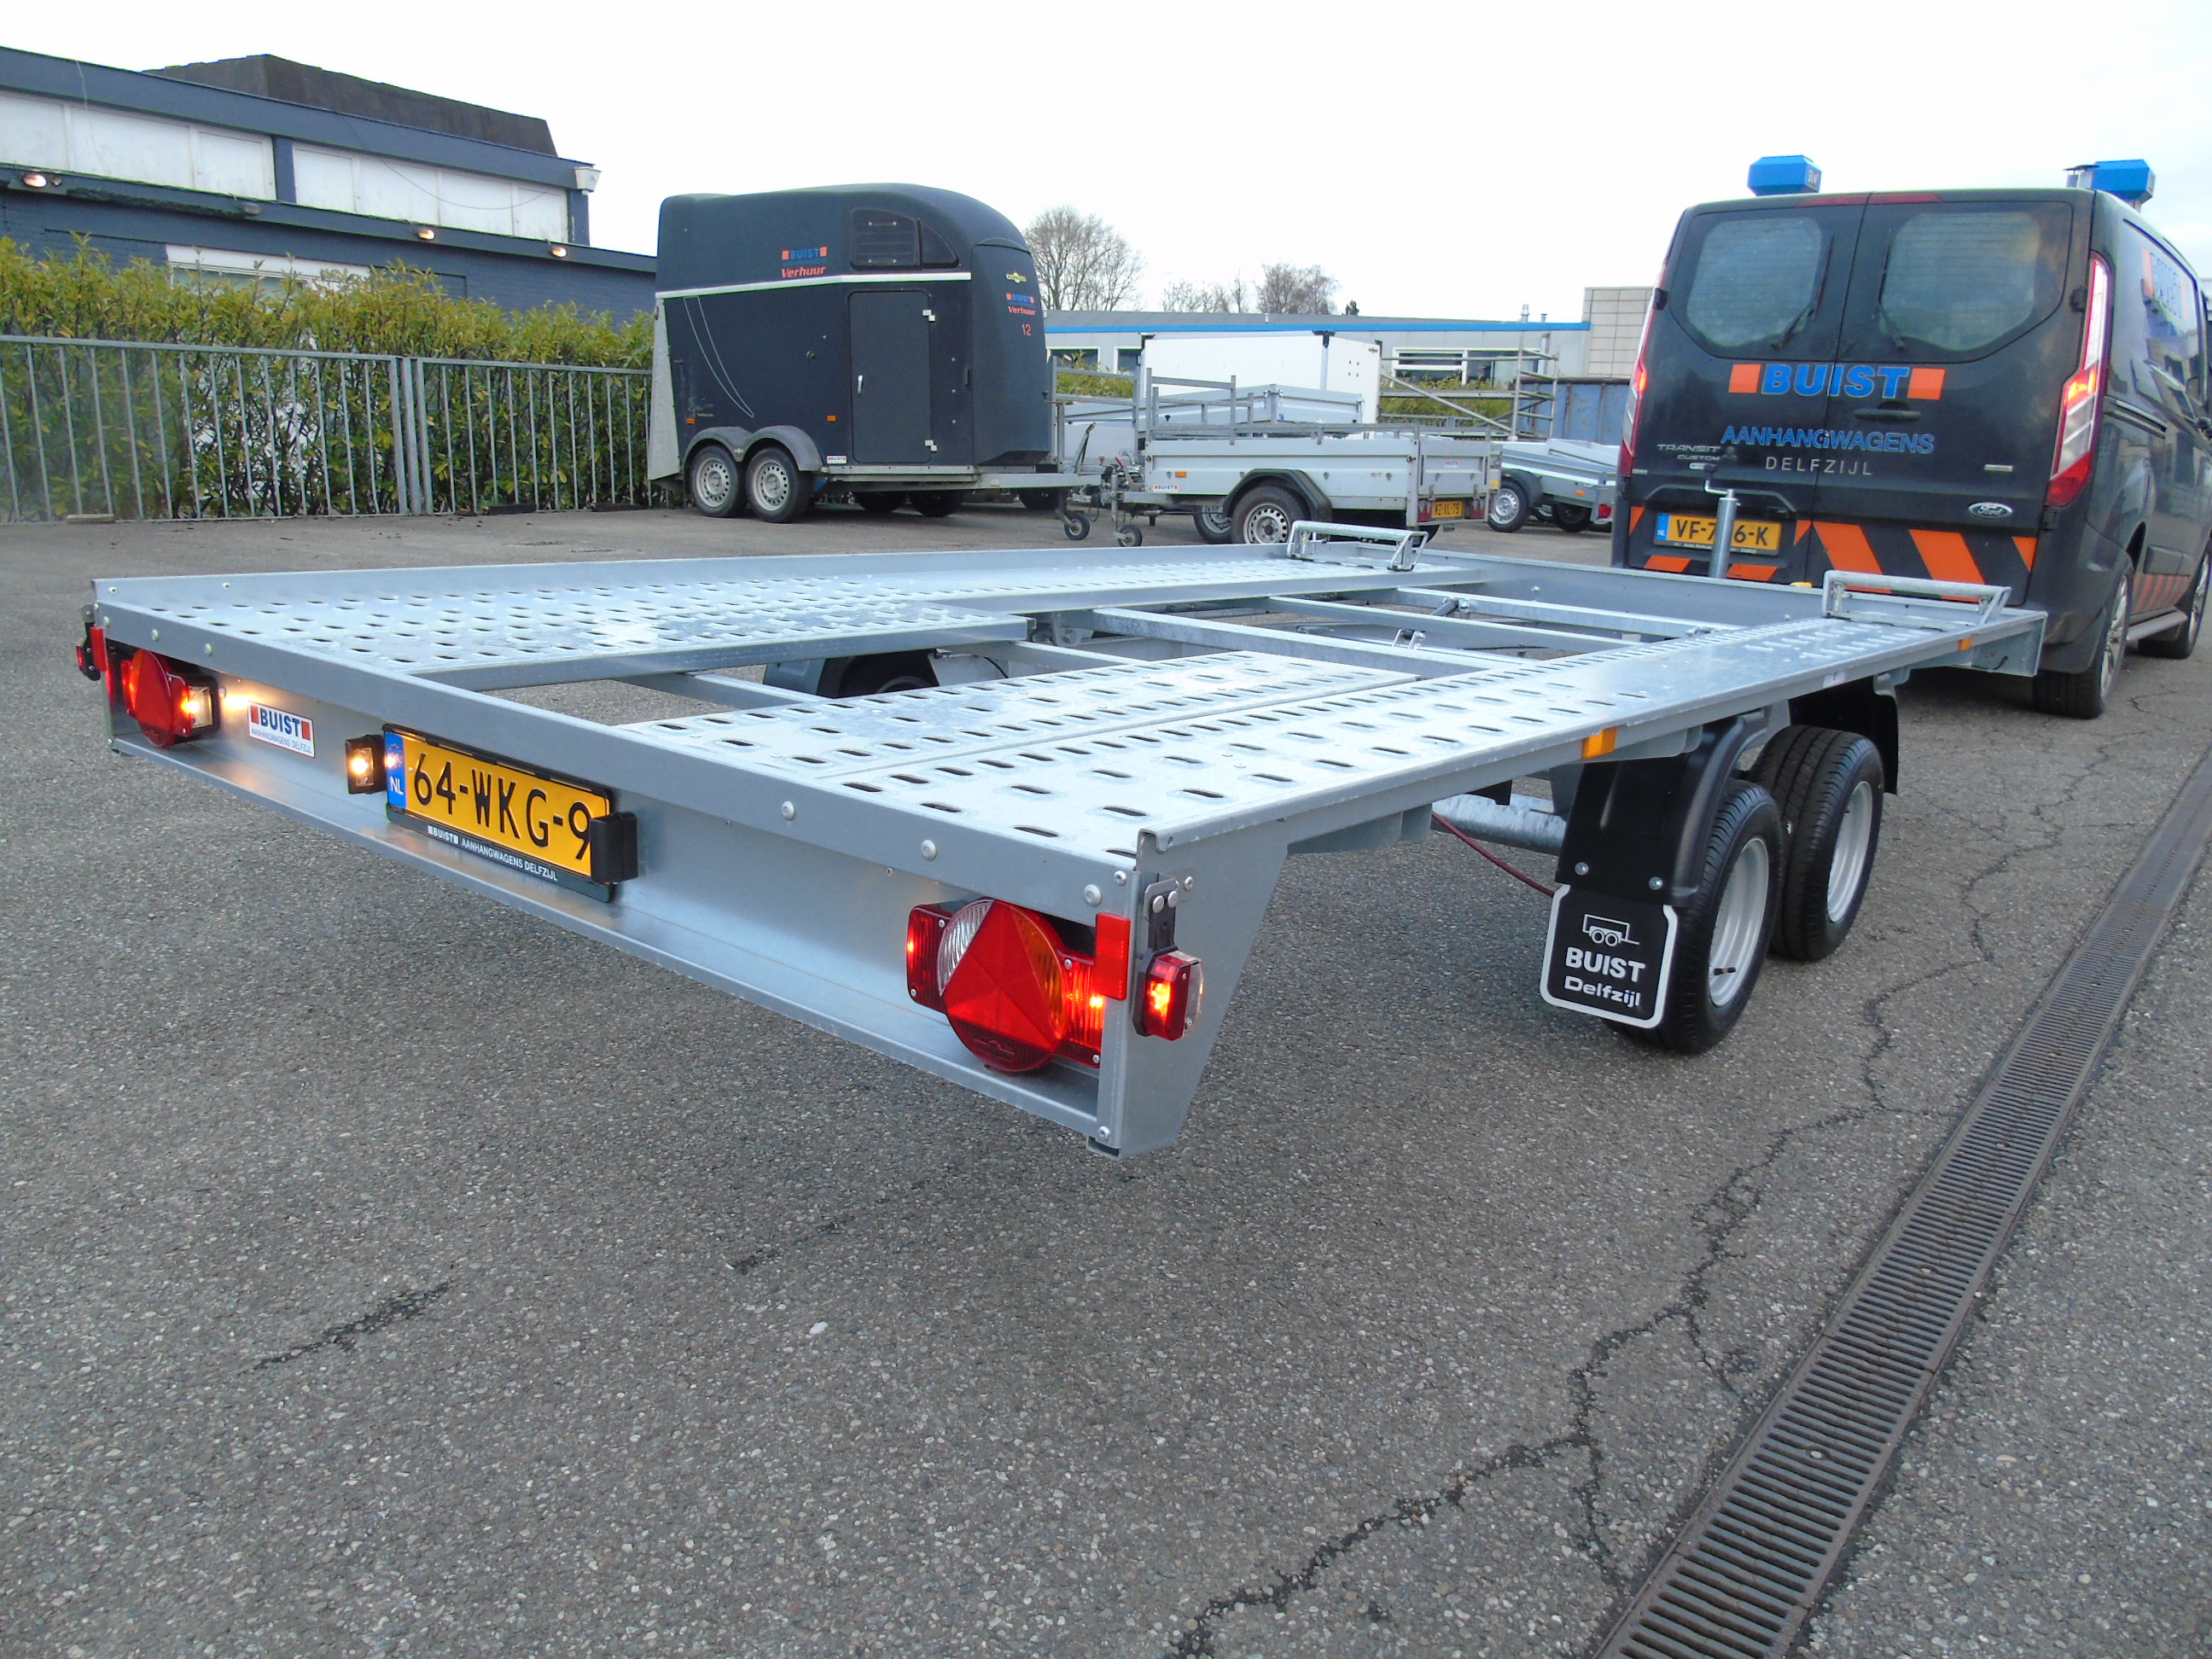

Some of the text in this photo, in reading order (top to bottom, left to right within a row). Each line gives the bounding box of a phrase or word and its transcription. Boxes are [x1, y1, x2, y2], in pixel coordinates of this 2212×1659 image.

[789, 248, 819, 259] BUIST
[782, 266, 826, 278] Verhuur
[1008, 306, 1036, 316] Verhuur
[1022, 323, 1032, 336] 12
[1761, 364, 1909, 399] BUIST
[1656, 444, 1720, 453] TRANSIT
[1720, 427, 1935, 453] AANHANGWAGENS
[1766, 457, 1872, 476] DELFZIJL
[1977, 505, 2003, 516] Ford
[1676, 518, 1769, 546] VF-76-K
[259, 707, 300, 737] BUIST
[390, 776, 404, 795] NL
[413, 753, 591, 861] 64-WKG-9
[433, 826, 558, 882] BUIST AANHANGWAGENS DELFZIJL
[1565, 946, 1646, 983] BUIST
[1564, 975, 1641, 1008] Delfzijl
